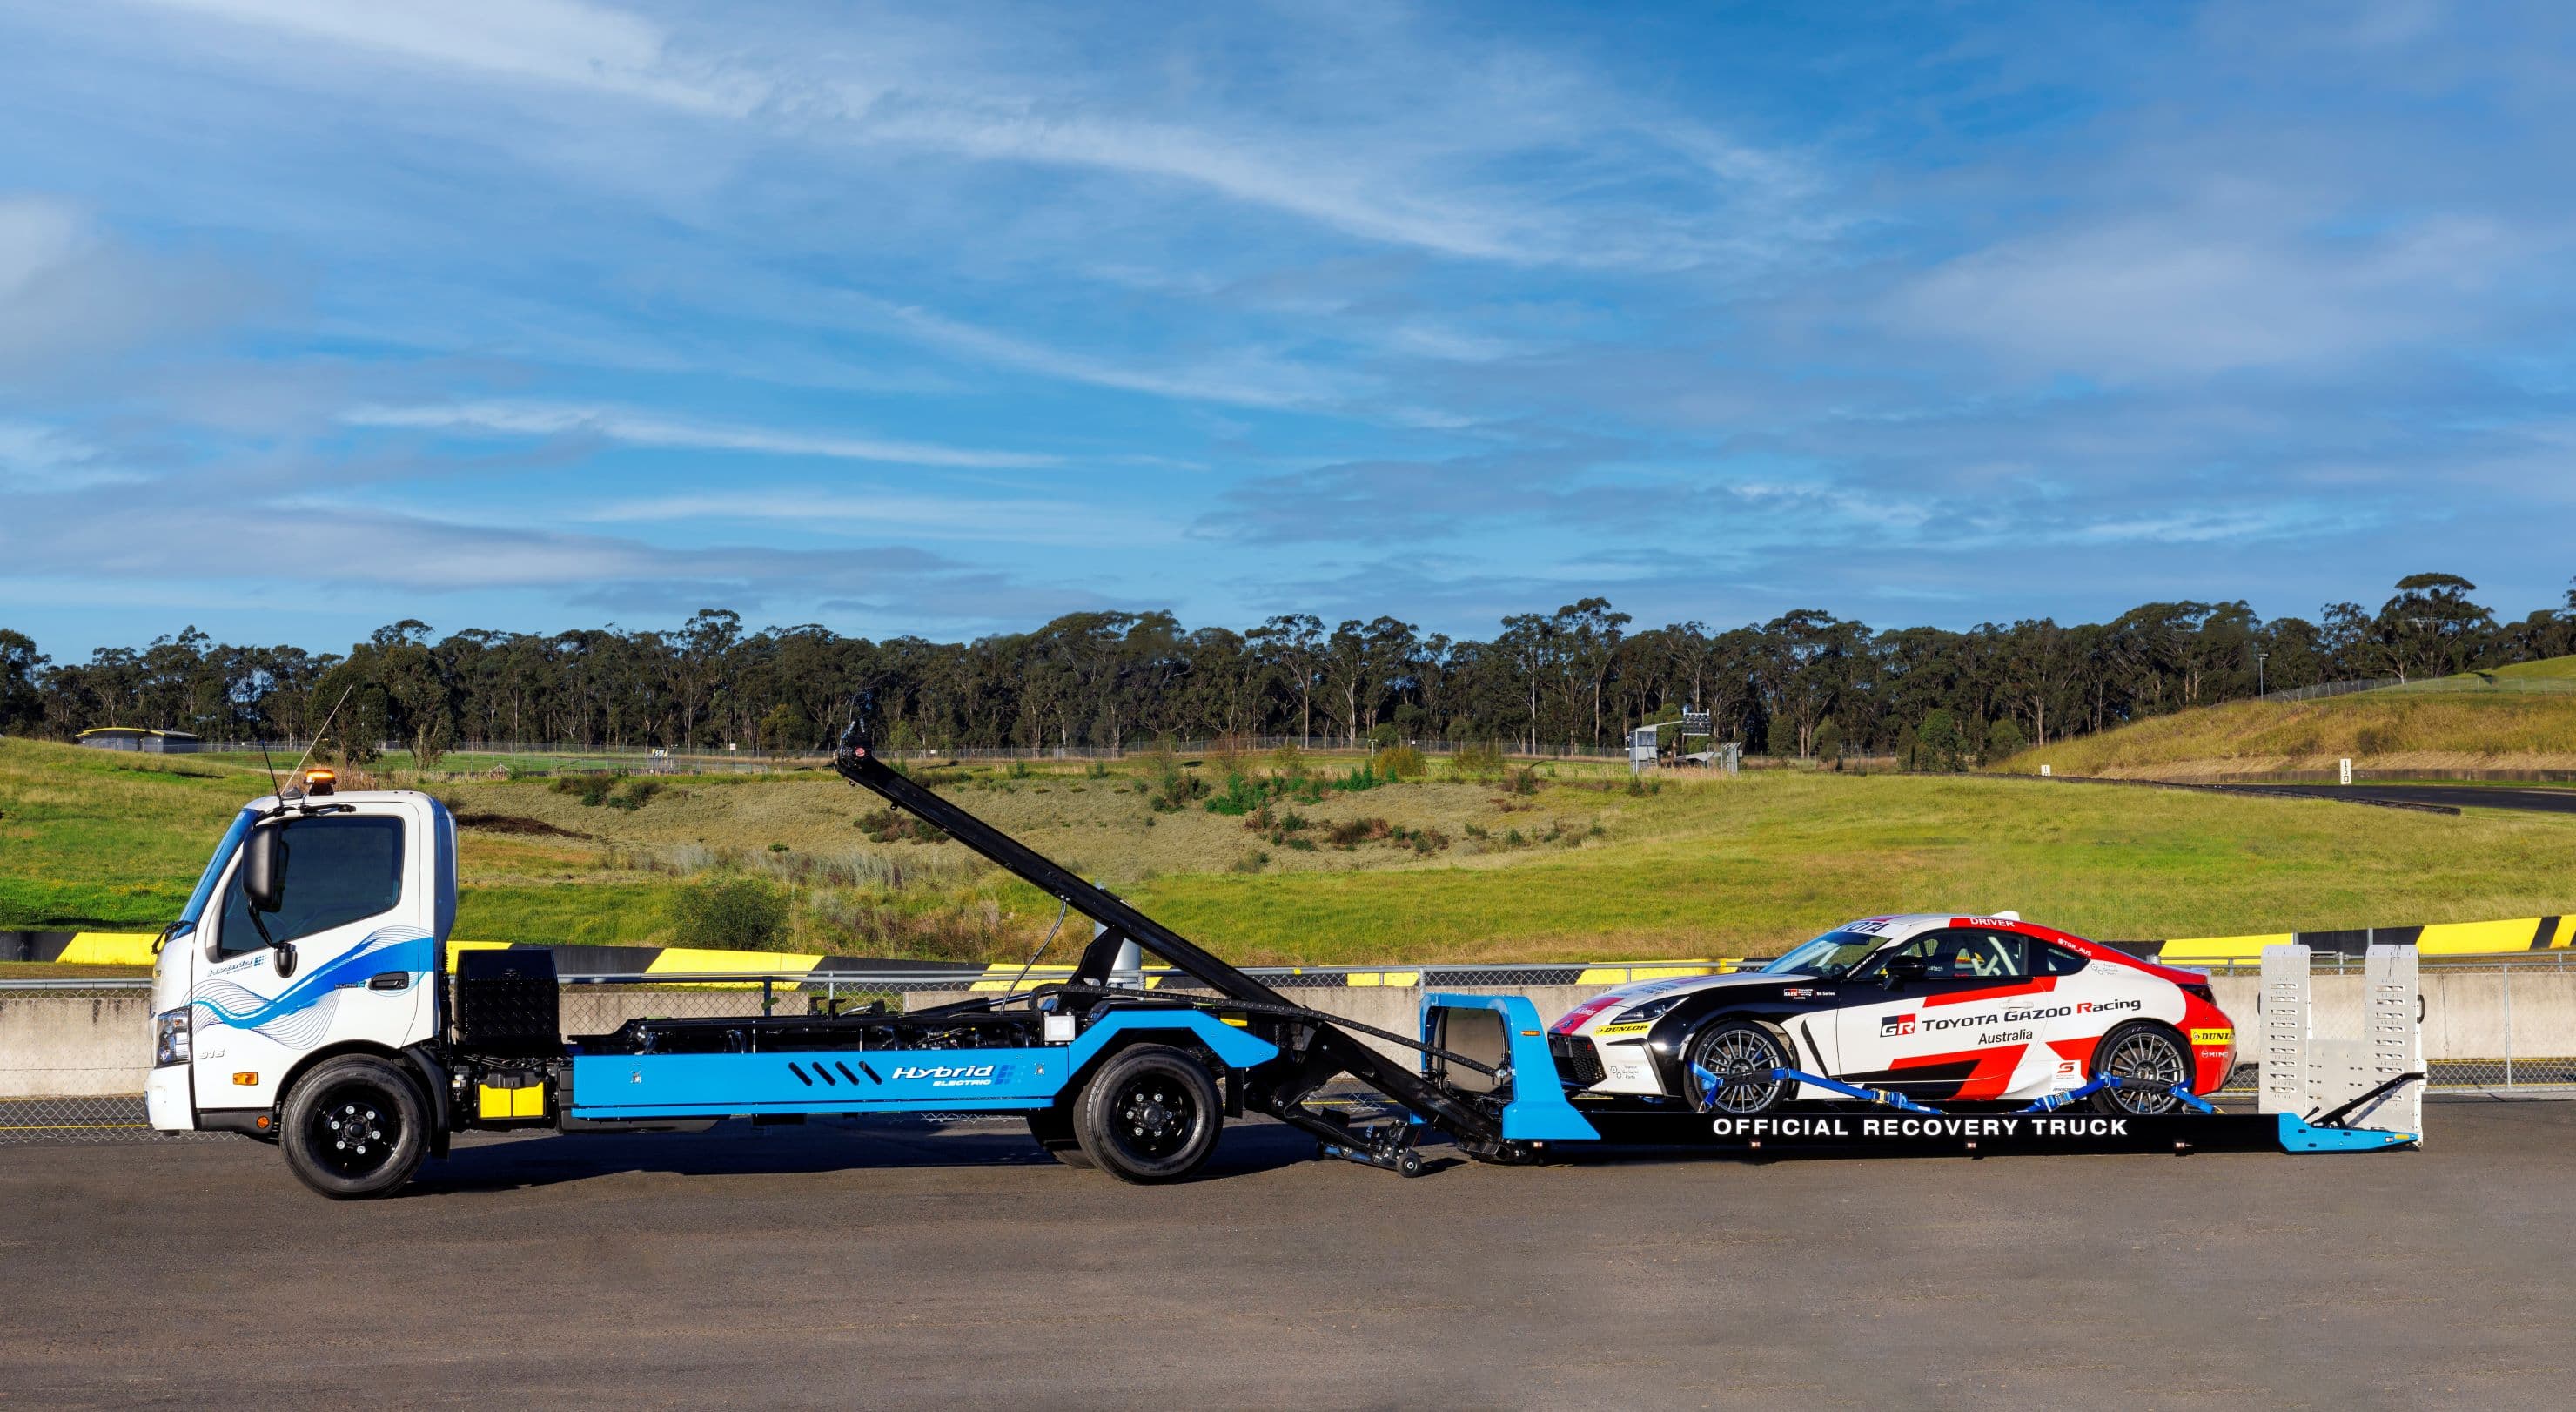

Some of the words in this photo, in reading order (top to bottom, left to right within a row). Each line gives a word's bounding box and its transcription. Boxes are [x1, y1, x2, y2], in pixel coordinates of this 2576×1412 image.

[1969, 918, 2016, 927] DRIVER
[2057, 938, 2092, 957] @TGR_AUS
[1922, 1014, 1999, 1031] TOYOTA
[2003, 1005, 2071, 1022] GAZOO
[2076, 998, 2142, 1014] Racing
[1881, 1021, 1915, 1036] GR
[1977, 1028, 2034, 1045] Australia
[891, 1065, 996, 1079] Hybrid
[1713, 1118, 1848, 1136] OFFICIAL
[1863, 1118, 2019, 1136] RECOVERY
[2031, 1118, 2129, 1136] TRUCK
